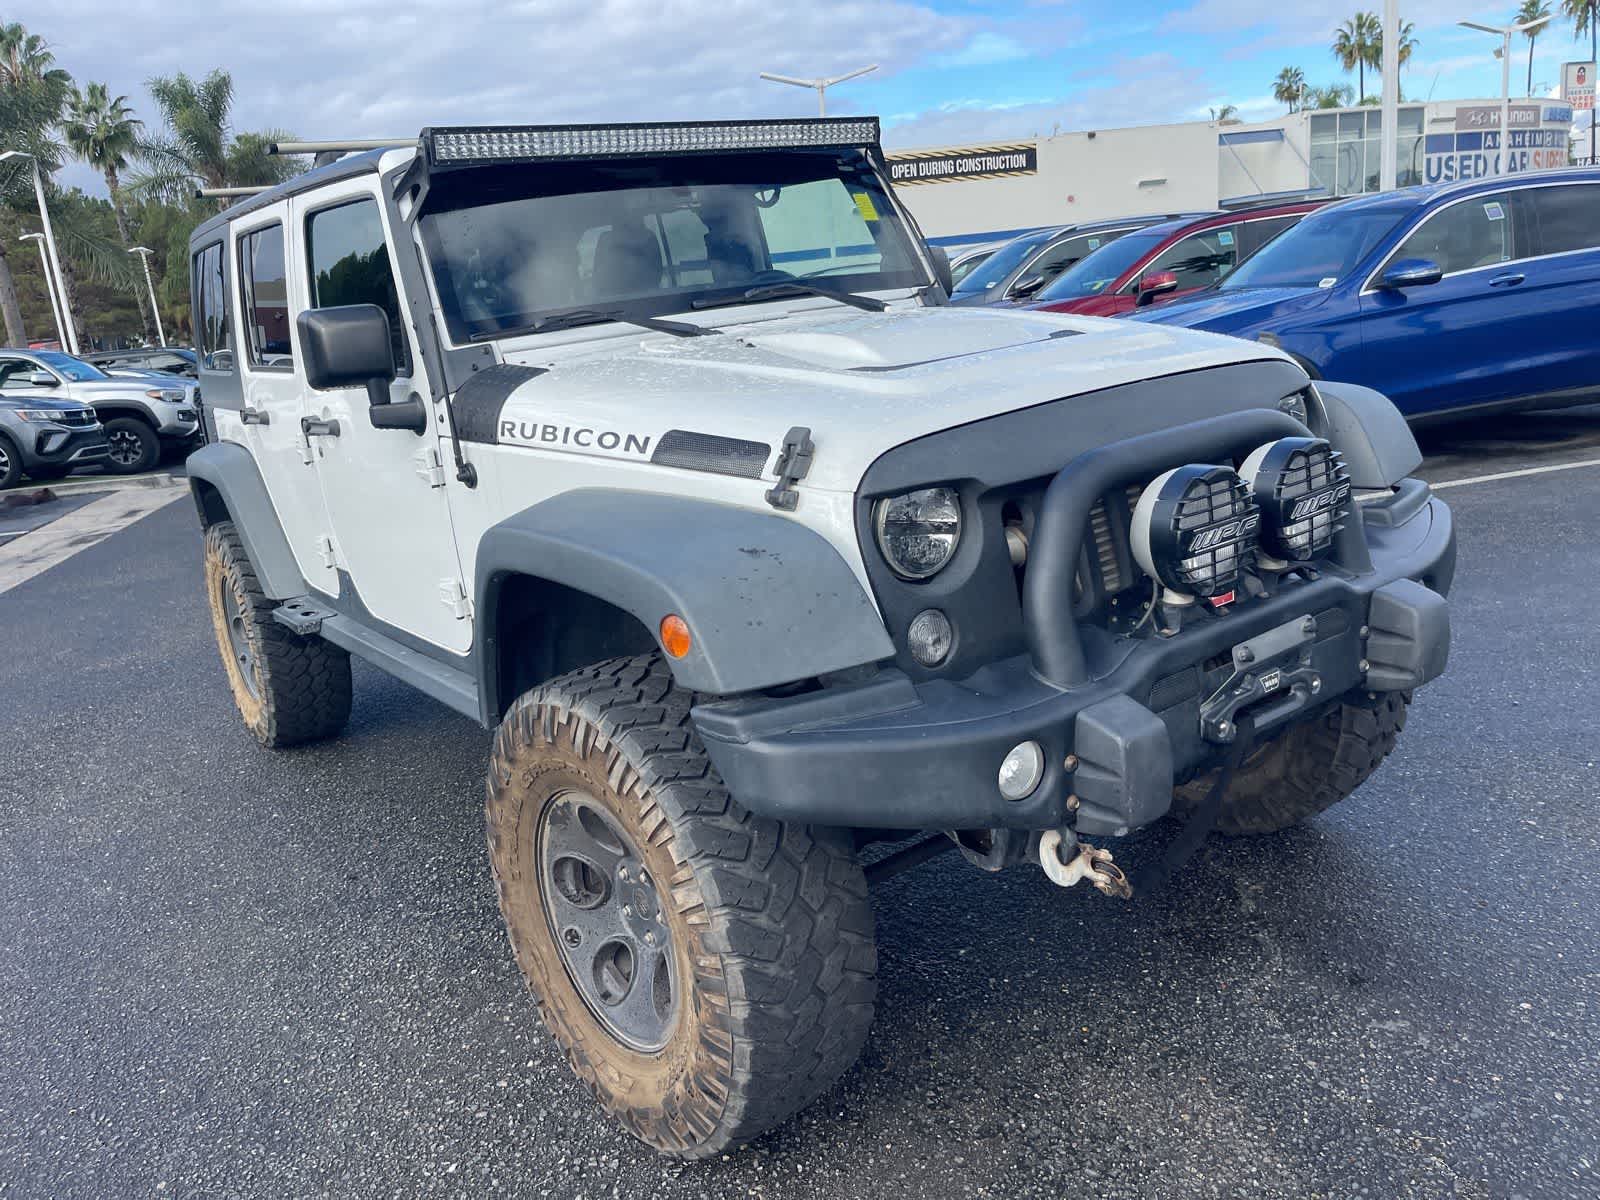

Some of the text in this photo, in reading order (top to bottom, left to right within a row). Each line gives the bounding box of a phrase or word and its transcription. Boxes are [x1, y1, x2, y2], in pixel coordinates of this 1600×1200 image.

[1490, 110, 1535, 124] HUNDAI
[891, 153, 1027, 179] OPEN DURING CONSTRUCTION
[1425, 153, 1487, 184] USED
[500, 420, 651, 455] RUBICON
